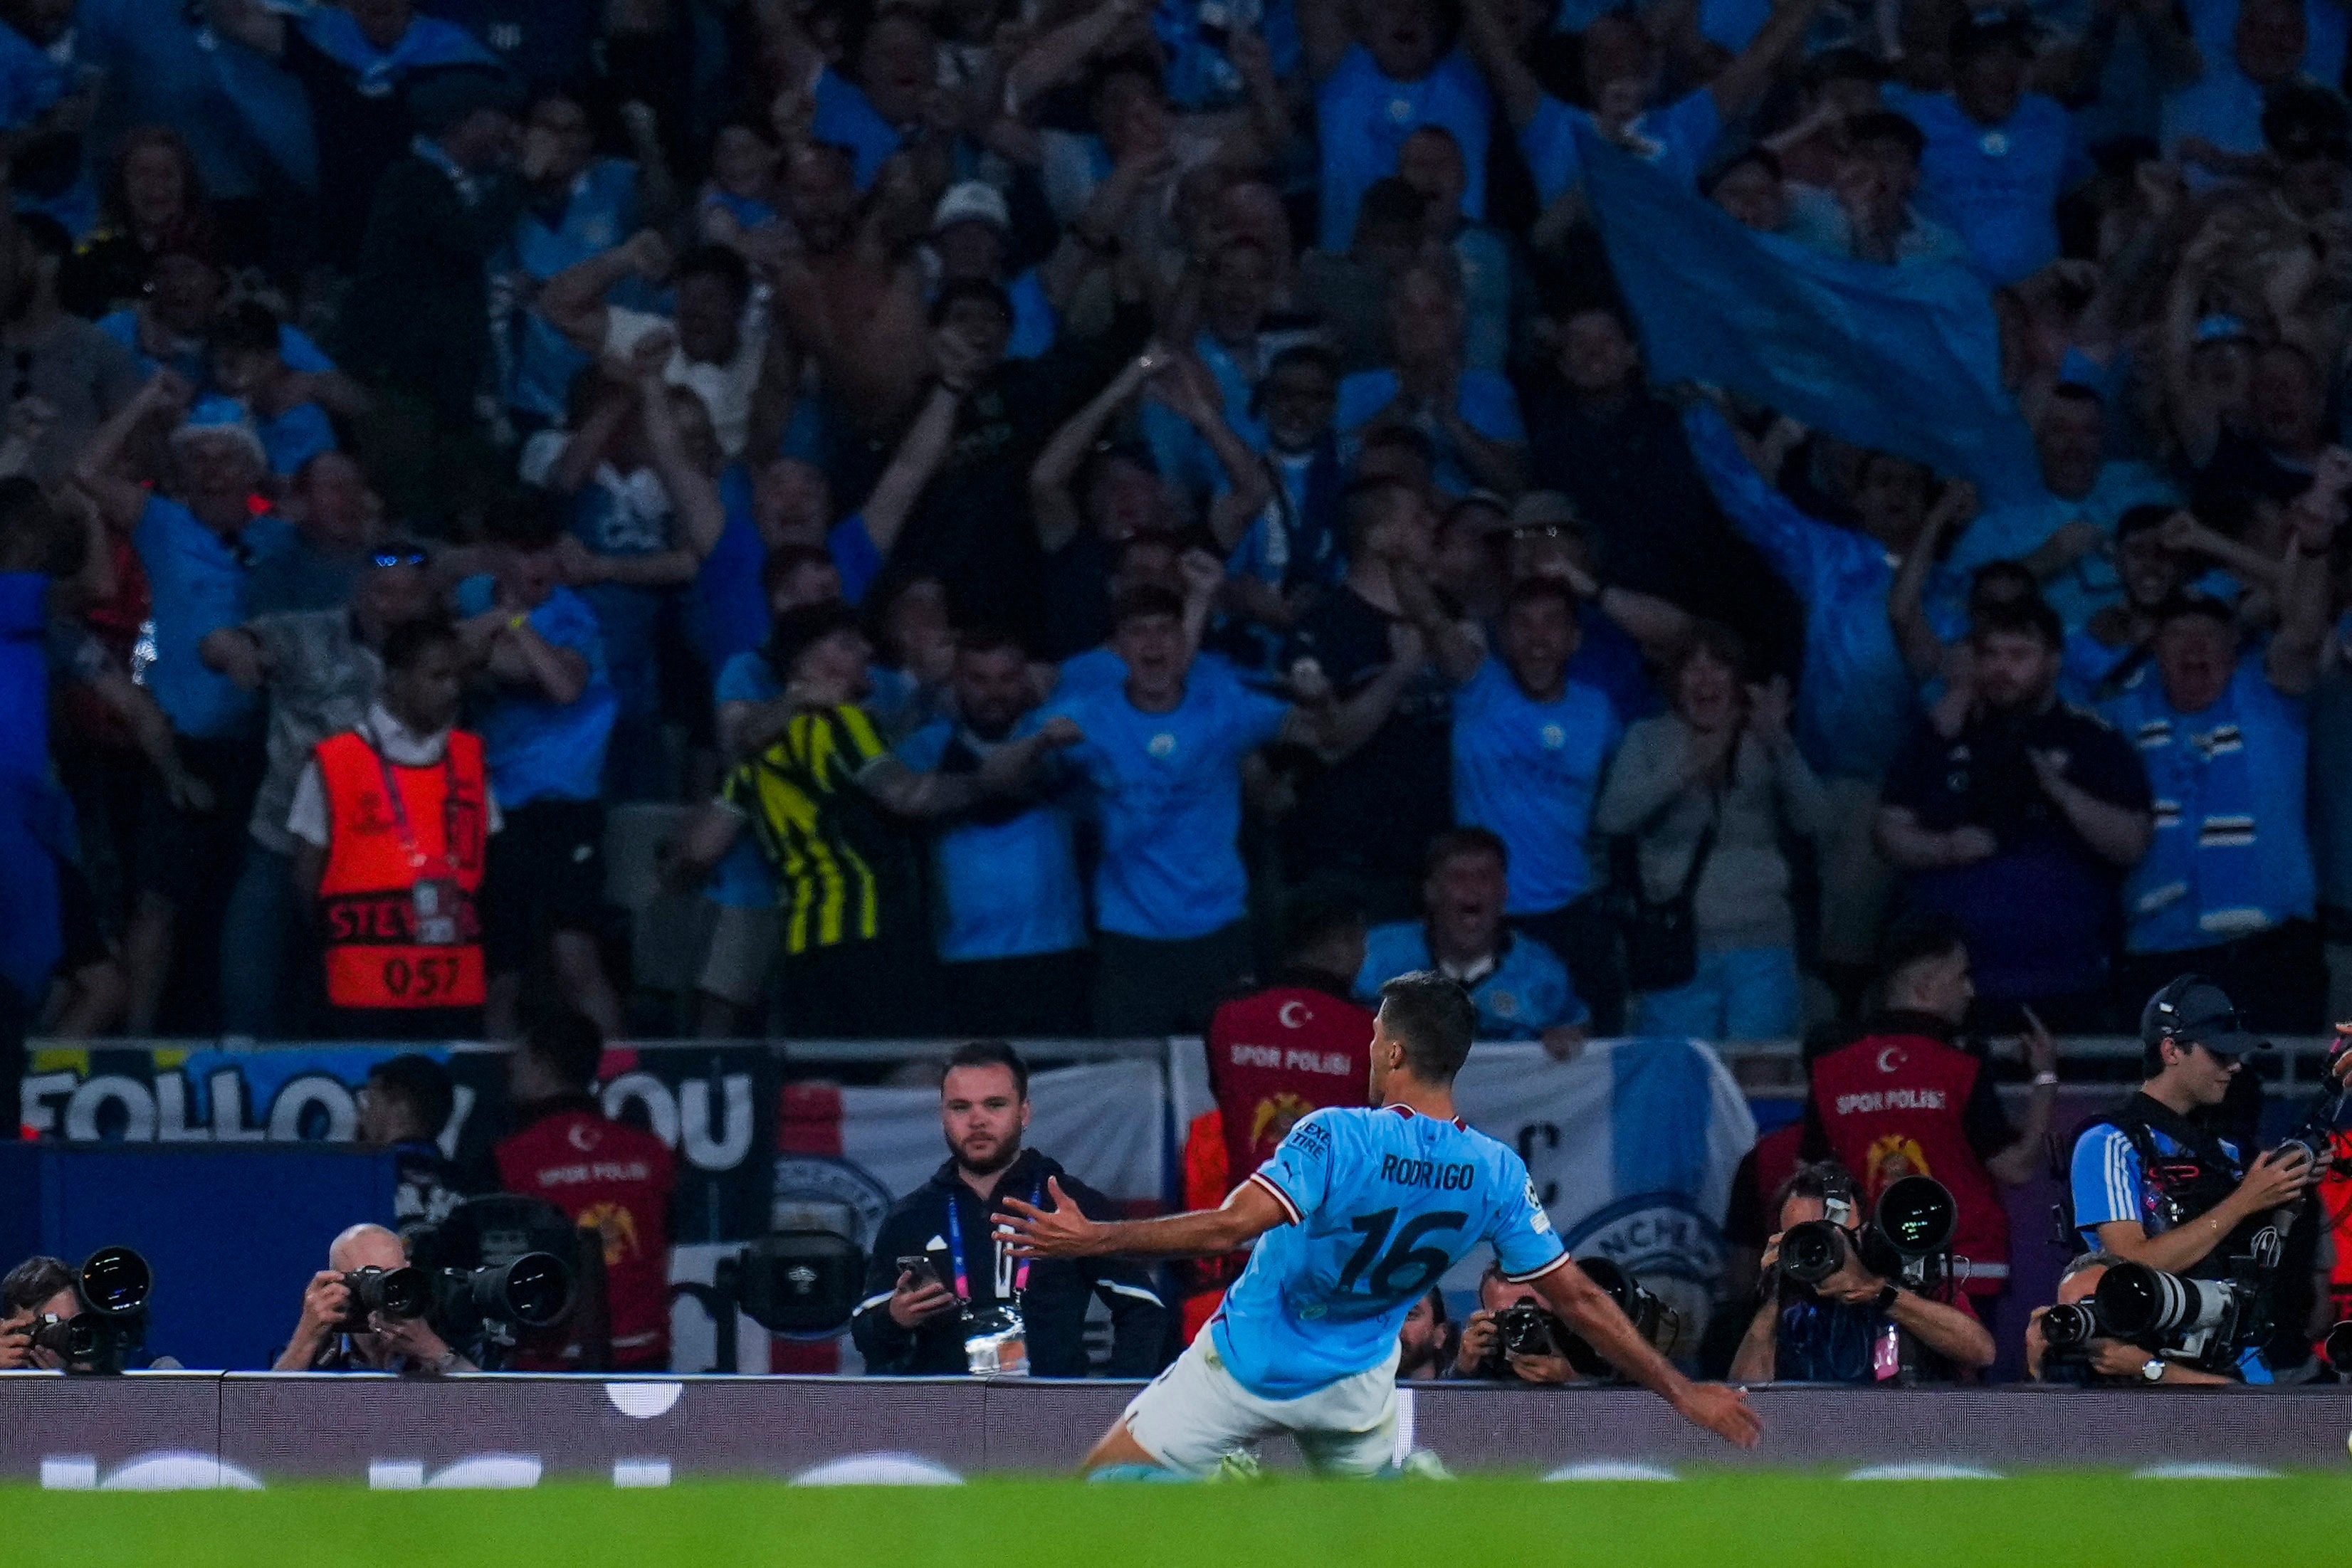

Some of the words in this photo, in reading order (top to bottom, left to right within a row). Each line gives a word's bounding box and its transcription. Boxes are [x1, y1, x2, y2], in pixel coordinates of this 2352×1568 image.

[383, 957, 460, 997] 057
[1231, 1044, 1281, 1069] SPOR
[19, 1069, 476, 1160] FOLLO
[1836, 1091, 1884, 1115] SPOR
[1291, 1132, 1325, 1161] TIRE
[1380, 1153, 1475, 1191] RODRIGO
[1337, 1206, 1469, 1298] 16
